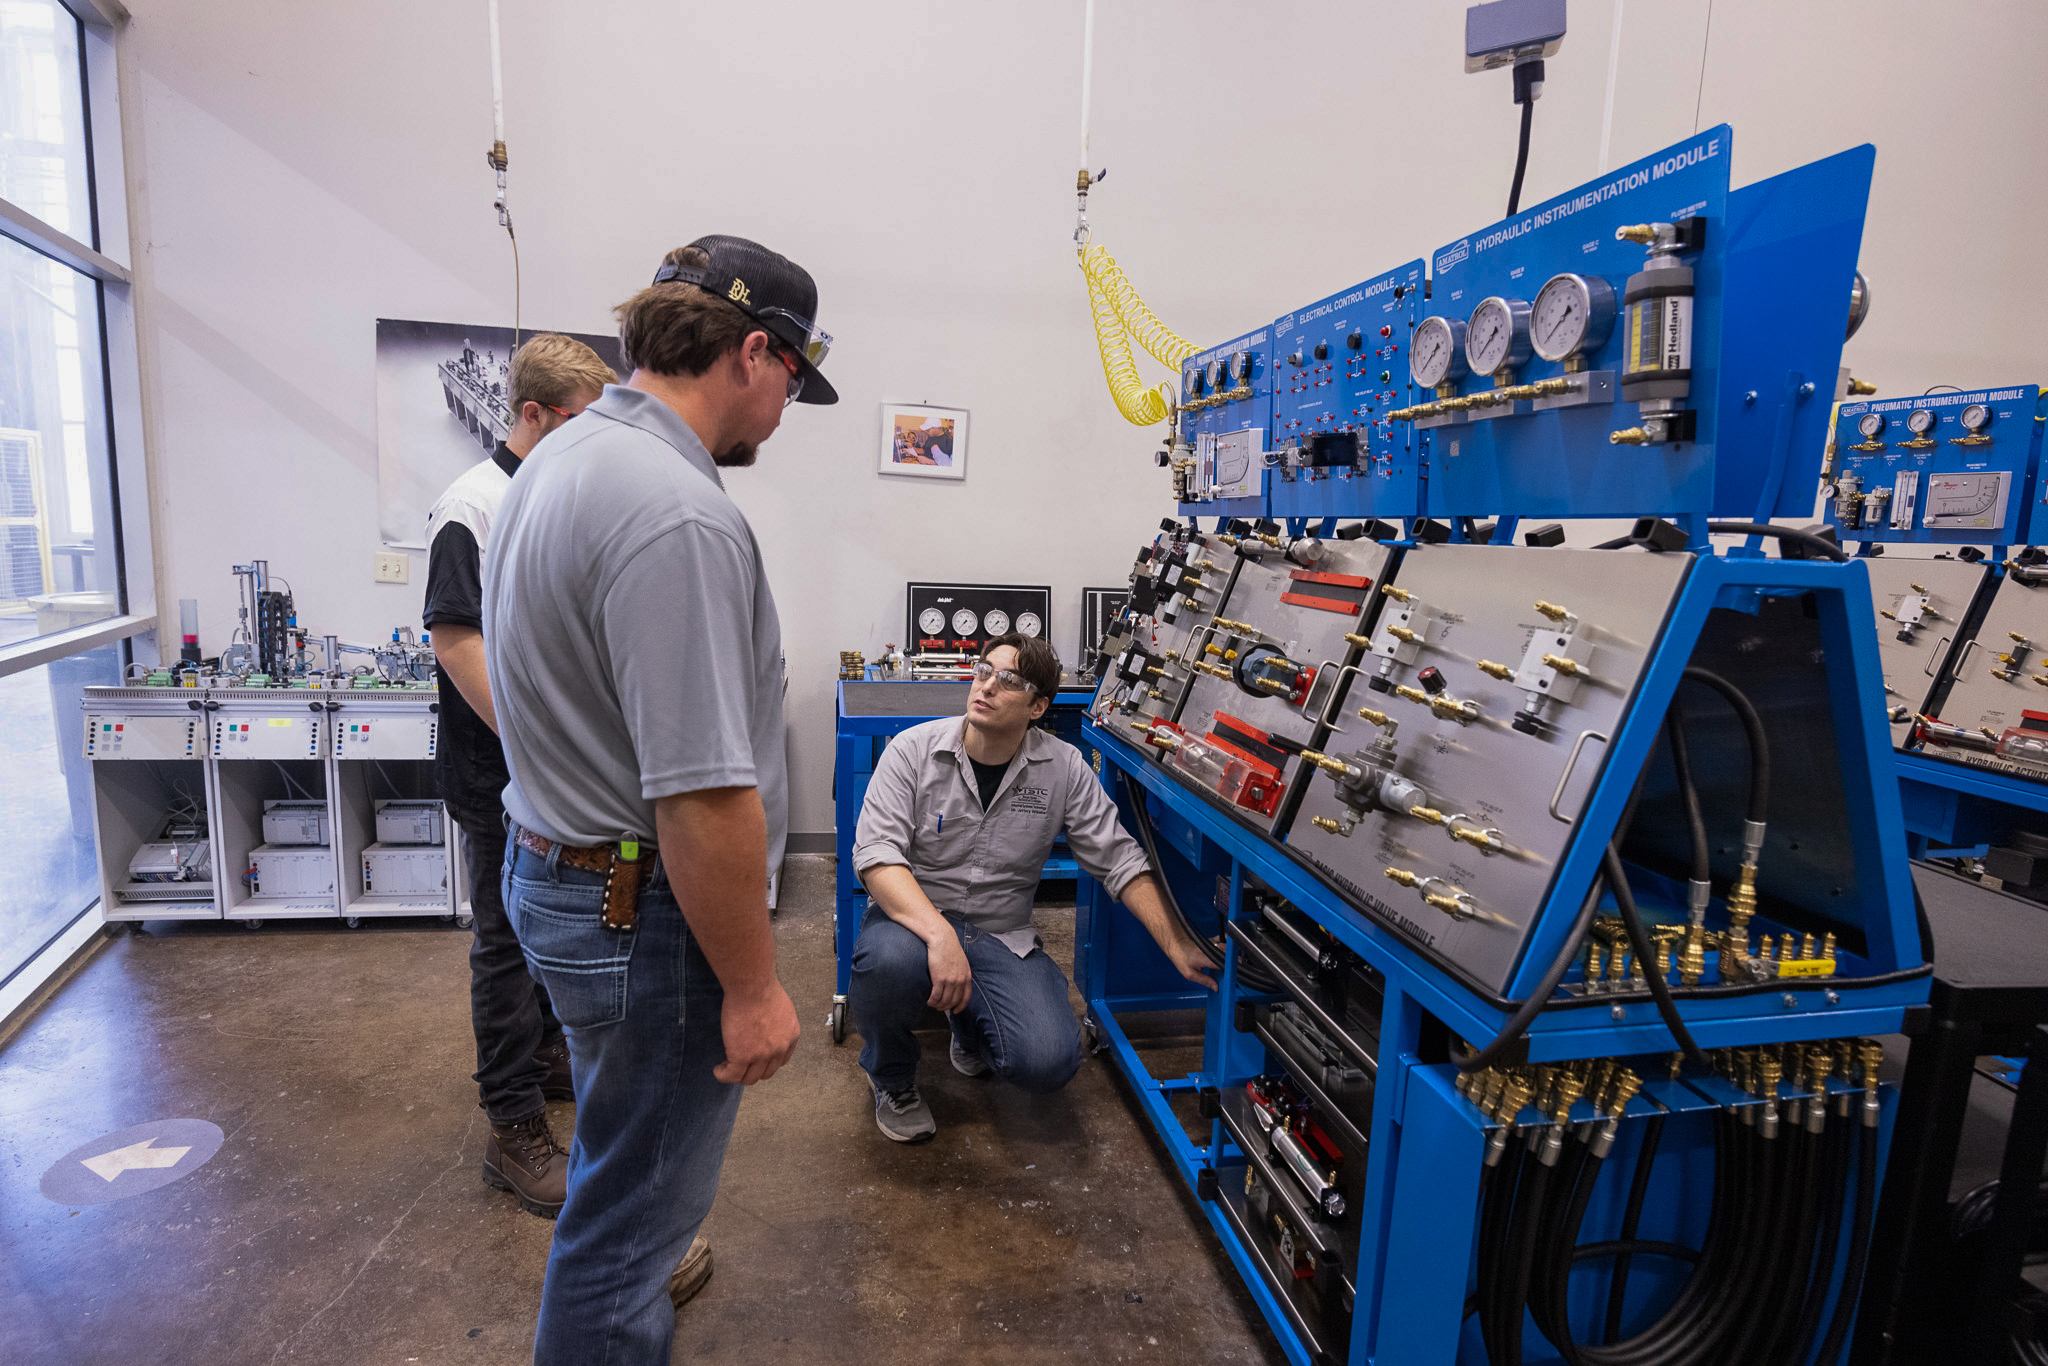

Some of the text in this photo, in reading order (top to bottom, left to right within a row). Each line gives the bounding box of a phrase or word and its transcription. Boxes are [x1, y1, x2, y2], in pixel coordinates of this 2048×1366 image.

[1476, 139, 1720, 254] HYDRAULIC INSTRUMENTATION MODULE
[1300, 277, 1395, 324] ELECTRICAL CONTROL MODULE
[1668, 301, 1678, 353] Hedland
[1871, 389, 2024, 412] PNEUMATIC INSTRUMENTATION MODULE
[1966, 756, 2012, 772] HYDRAULIC
[1336, 873, 1374, 906] HYDRAULIC
[1375, 899, 1398, 921] VALVE
[1398, 916, 1435, 946] MODULE
